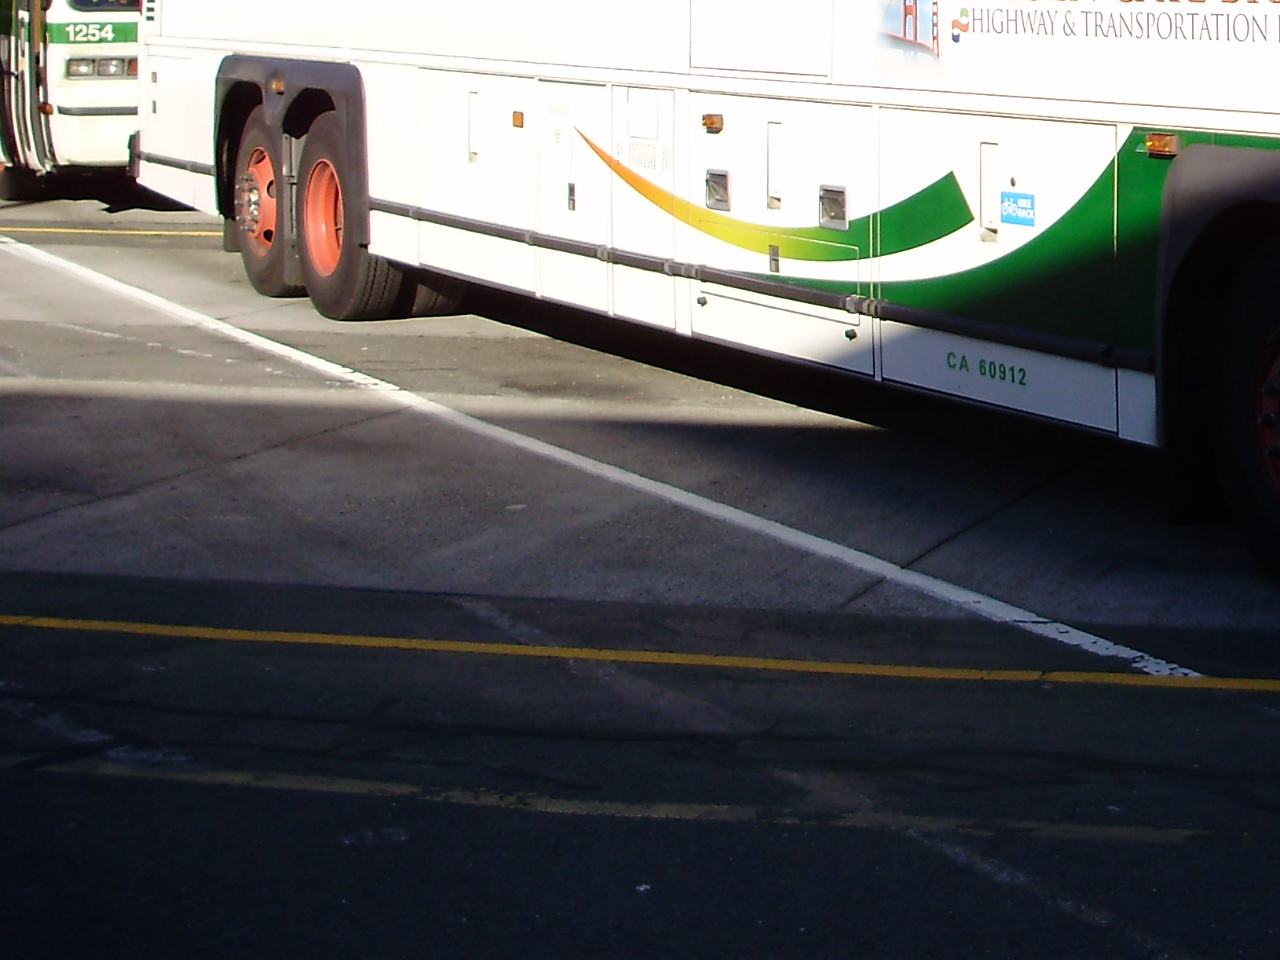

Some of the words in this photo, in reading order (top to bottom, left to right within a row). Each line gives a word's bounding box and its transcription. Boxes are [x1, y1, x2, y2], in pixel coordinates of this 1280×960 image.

[65, 24, 115, 42] 1254
[971, 8, 1058, 37] HIGHWAY
[1062, 10, 1077, 37] &
[1080, 10, 1268, 43] TRANSPORTATION
[1017, 198, 1032, 208] BIKE
[1017, 208, 1034, 219] RACK
[947, 351, 970, 373] CA
[979, 358, 1026, 386] 60912
